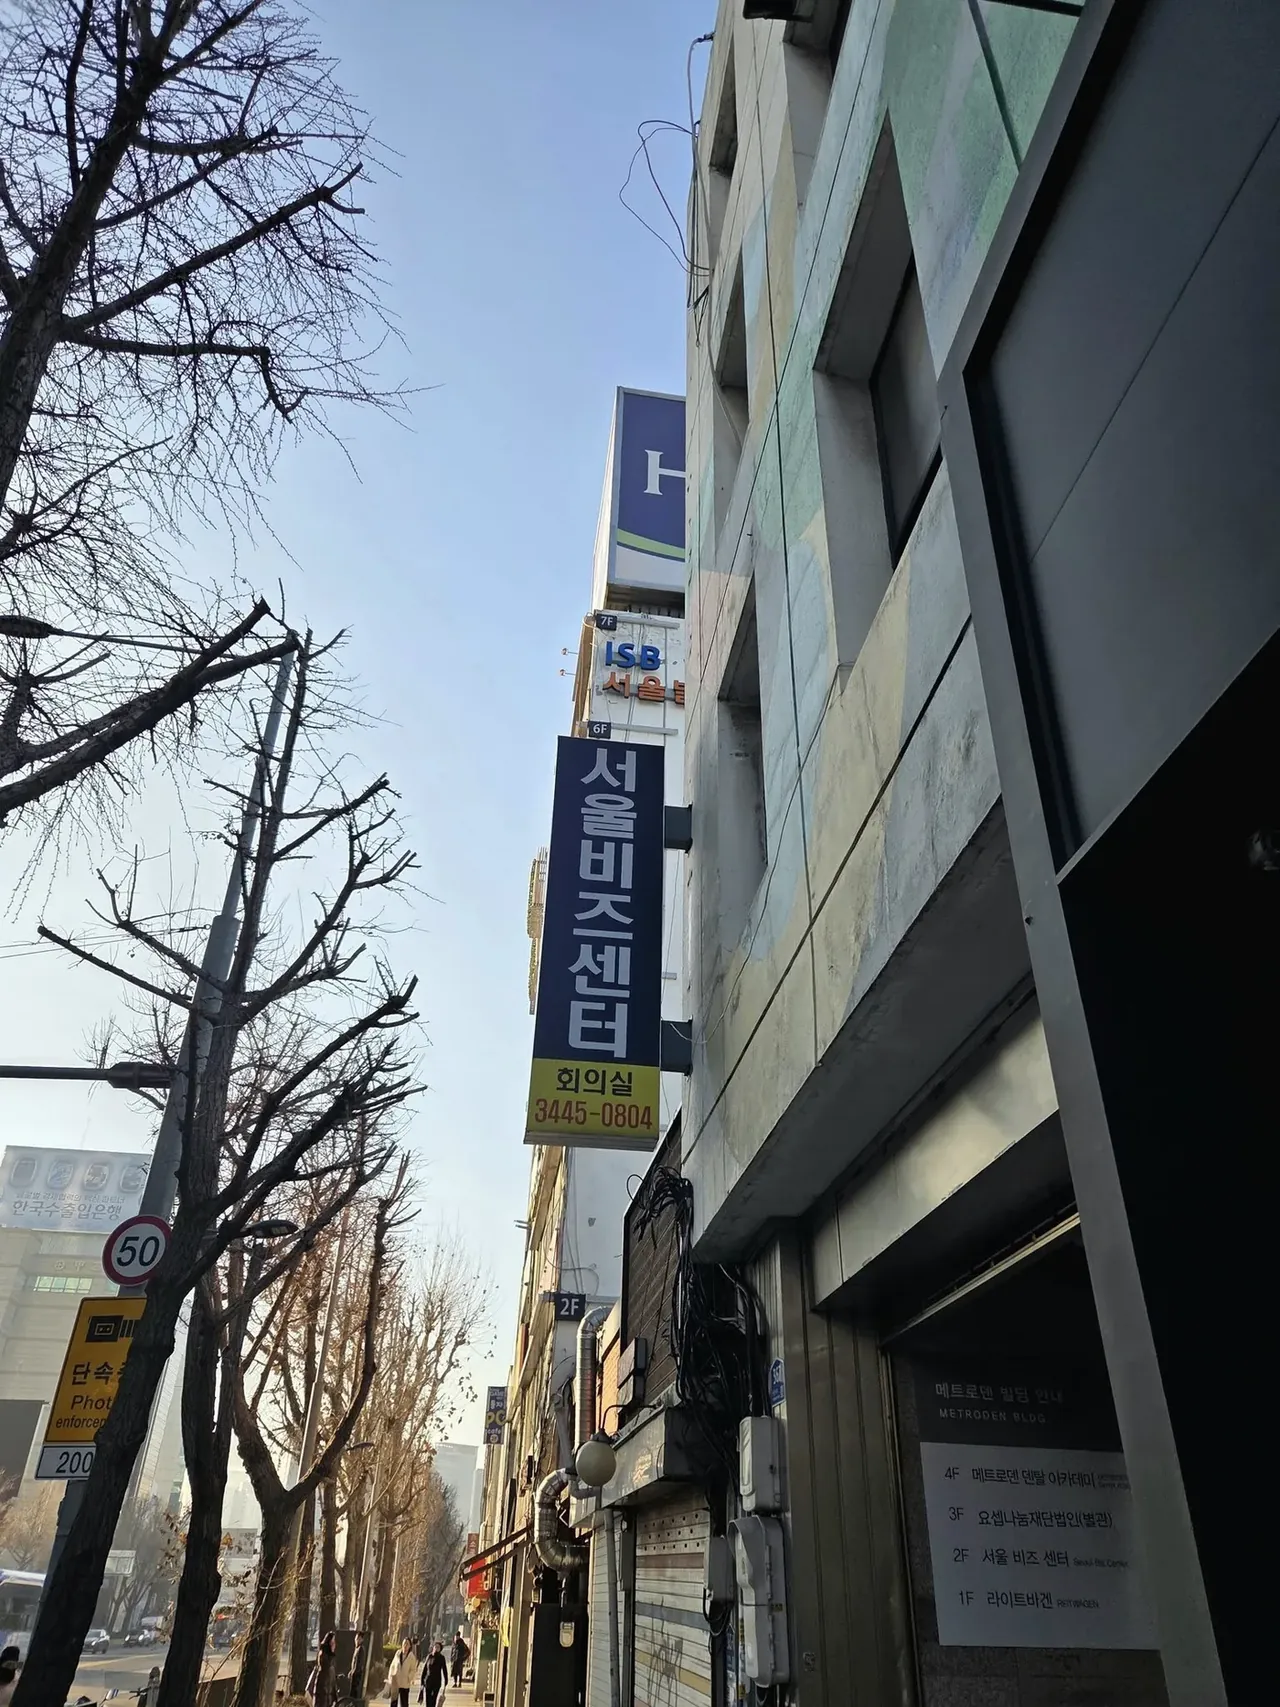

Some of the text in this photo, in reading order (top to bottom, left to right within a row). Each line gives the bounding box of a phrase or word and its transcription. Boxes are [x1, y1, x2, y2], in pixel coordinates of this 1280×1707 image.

[600, 615, 614, 627] 7F
[605, 640, 661, 671] ISB
[592, 723, 608, 735] 6F
[568, 747, 637, 1058] 서울비즈센터
[556, 1067, 633, 1097] 회의실
[534, 1098, 653, 1130] 3445-0804
[13, 1200, 122, 1220] 한국수출입은행
[116, 1236, 160, 1267] 50
[560, 1298, 580, 1315] 2F
[935, 1382, 994, 1401] 메트로덴
[939, 1408, 1007, 1422] METRODEN
[56, 1451, 95, 1474] 200
[944, 1466, 960, 1480] 4F
[972, 1467, 1020, 1485] 메트로덴
[1022, 1469, 1046, 1486] 덴탈
[1048, 1469, 1097, 1488] 아카데미
[948, 1506, 964, 1521] 3F
[953, 1548, 969, 1563] 2F
[983, 1548, 1008, 1566] 서울
[1012, 1549, 1040, 1566] 비즈
[1043, 1550, 1069, 1567] 센터
[958, 1590, 974, 1605] 1F
[987, 1592, 1054, 1608] 라이트바겐
